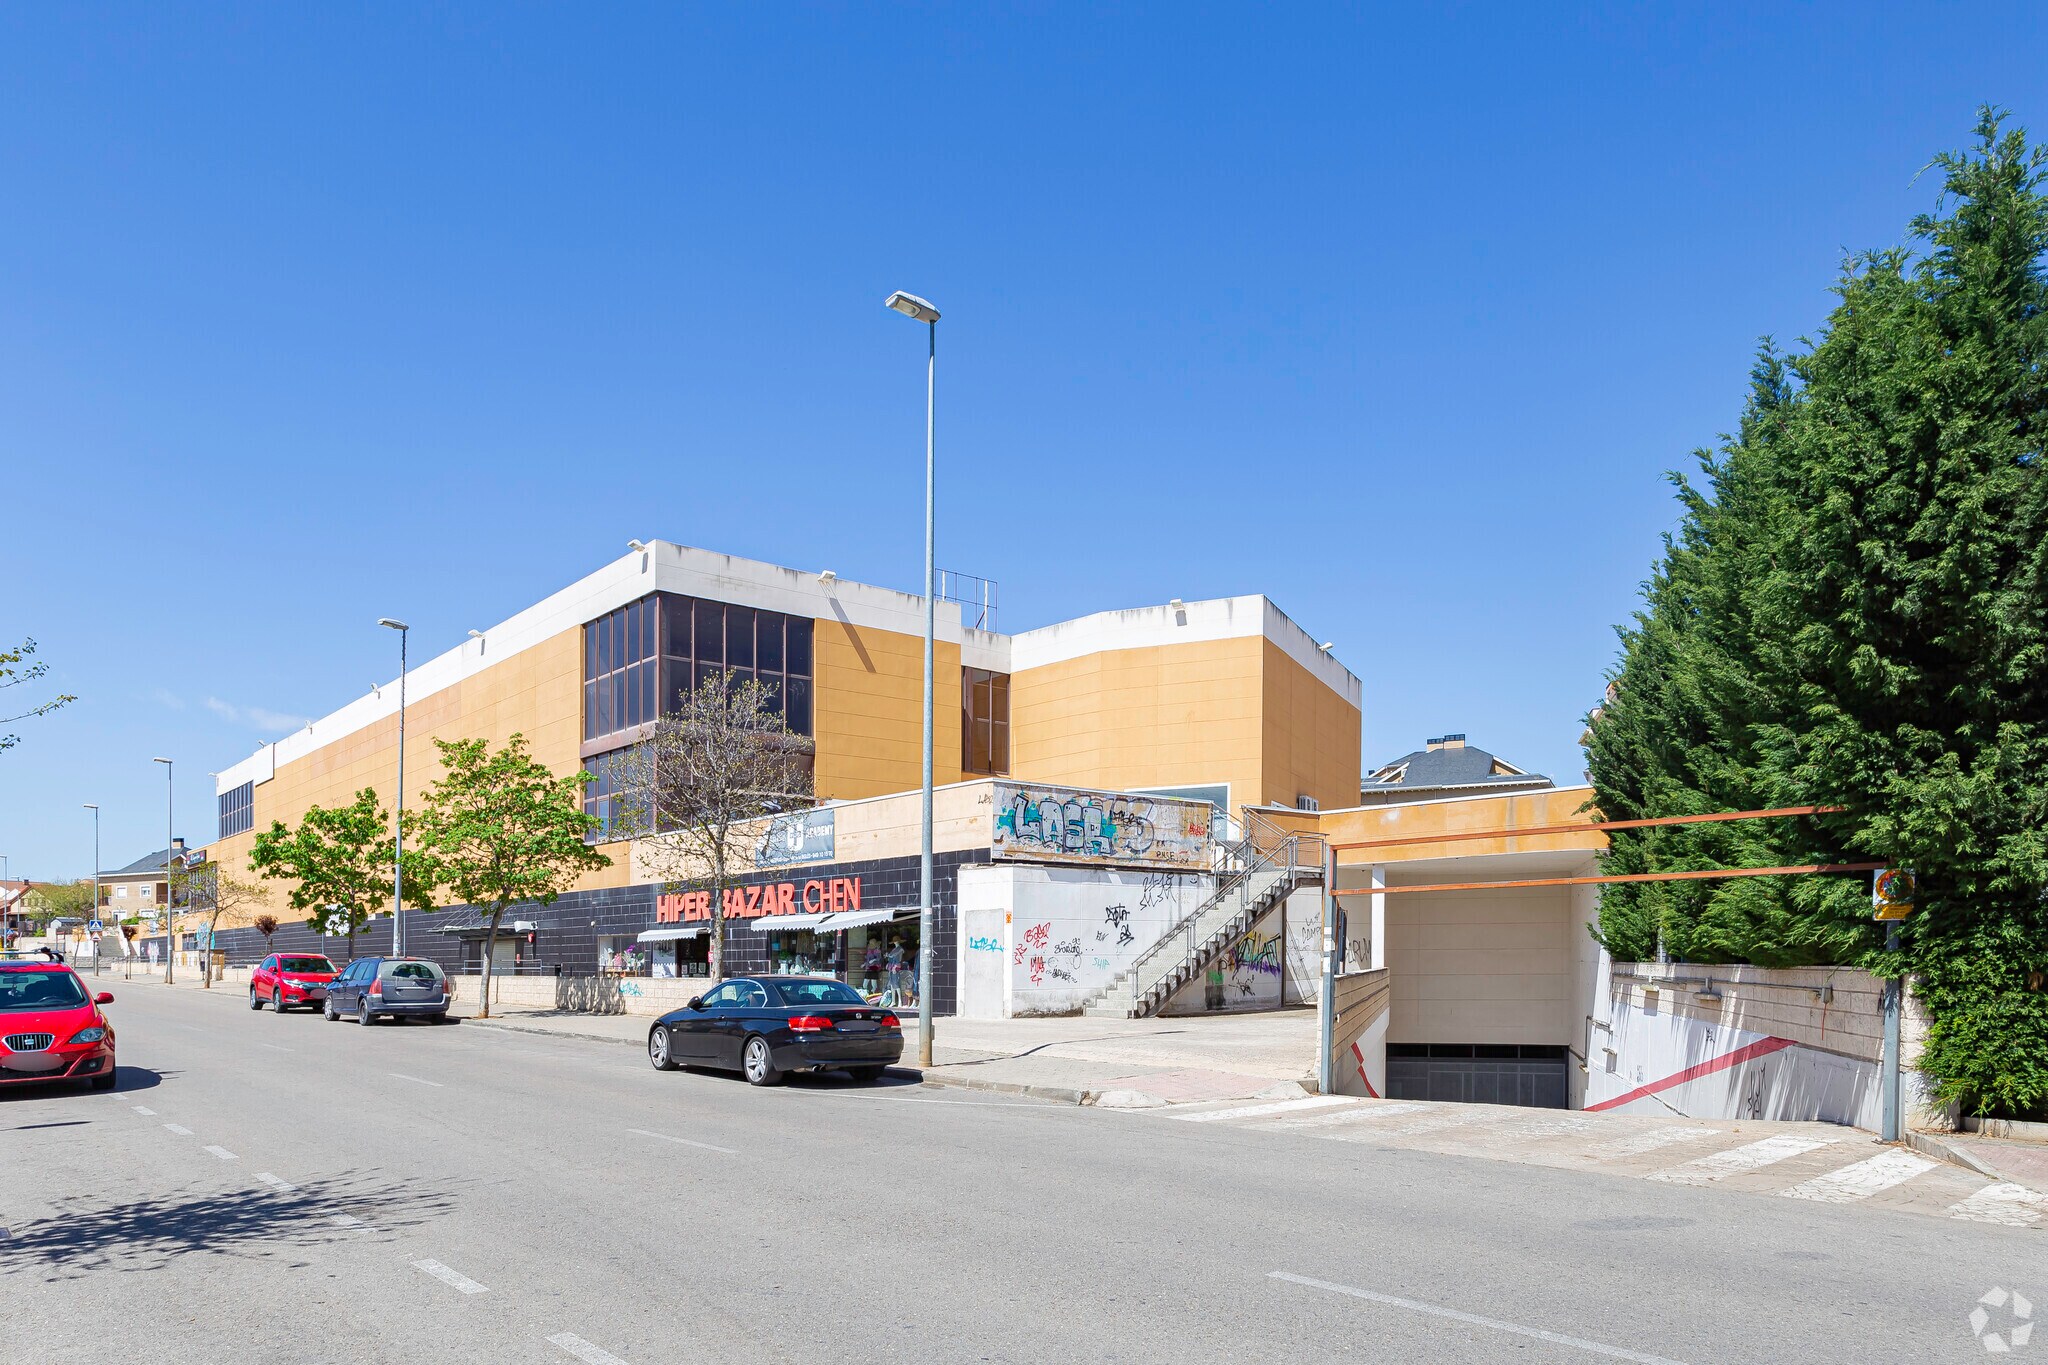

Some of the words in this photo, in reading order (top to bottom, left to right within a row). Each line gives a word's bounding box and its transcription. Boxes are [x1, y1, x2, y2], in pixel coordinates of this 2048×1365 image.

[805, 824, 834, 839] ACADEMY
[656, 891, 712, 923] HIPER
[802, 877, 861, 914] CHEN
